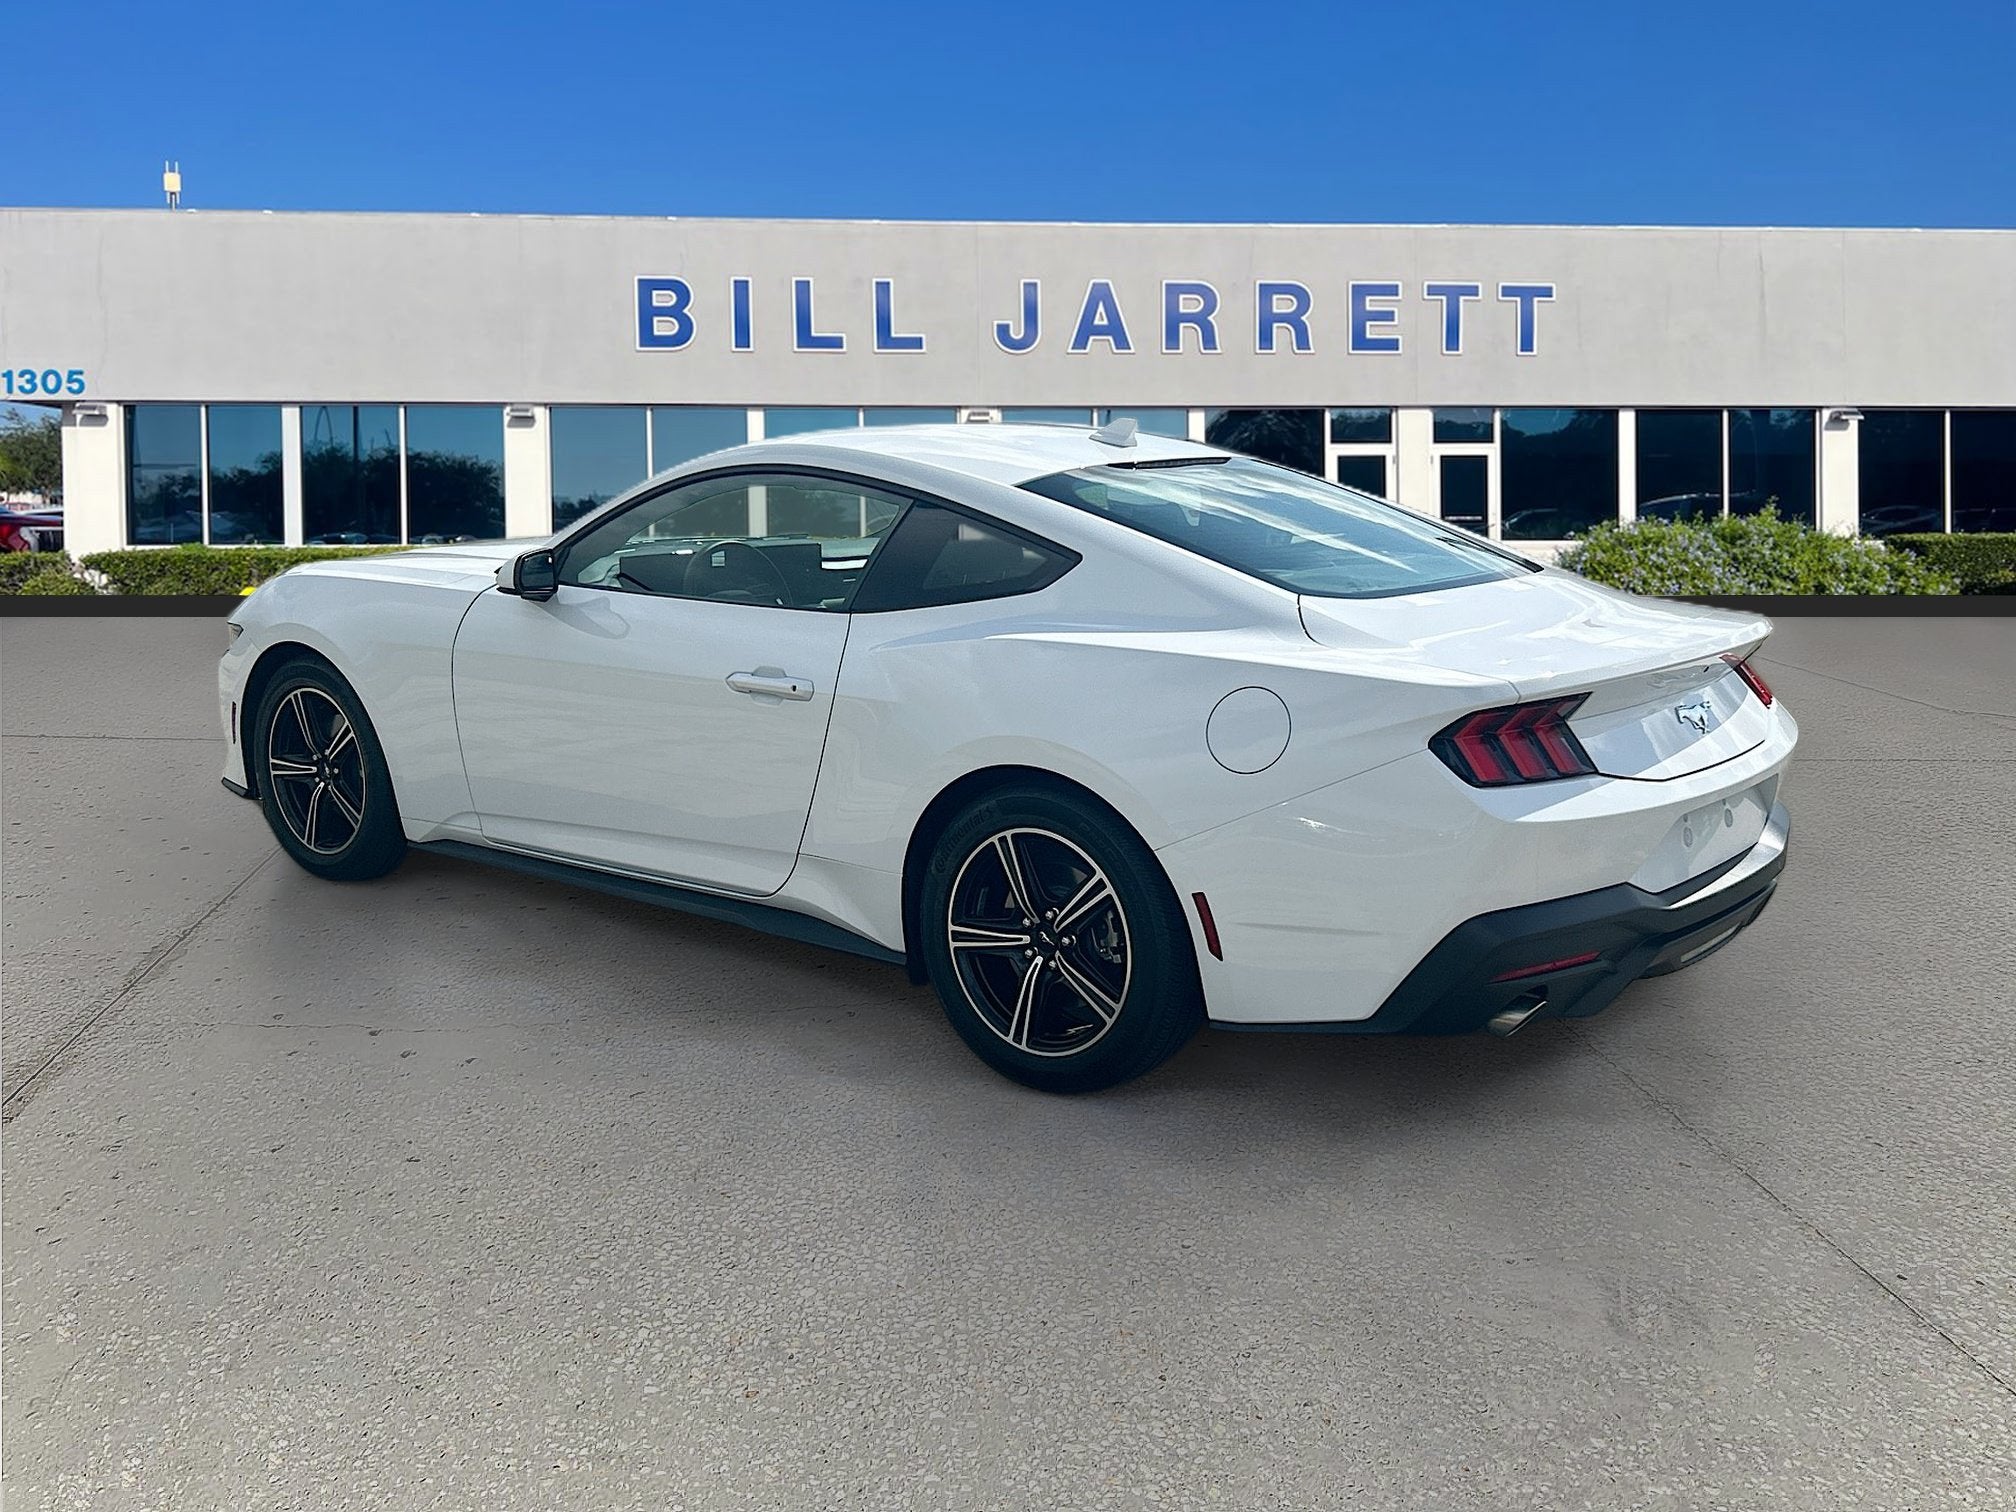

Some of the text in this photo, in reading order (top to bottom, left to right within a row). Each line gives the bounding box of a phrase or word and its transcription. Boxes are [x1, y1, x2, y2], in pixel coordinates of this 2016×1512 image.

[634, 274, 1555, 356] BILL JARRETT
[1, 369, 86, 395] 1305
